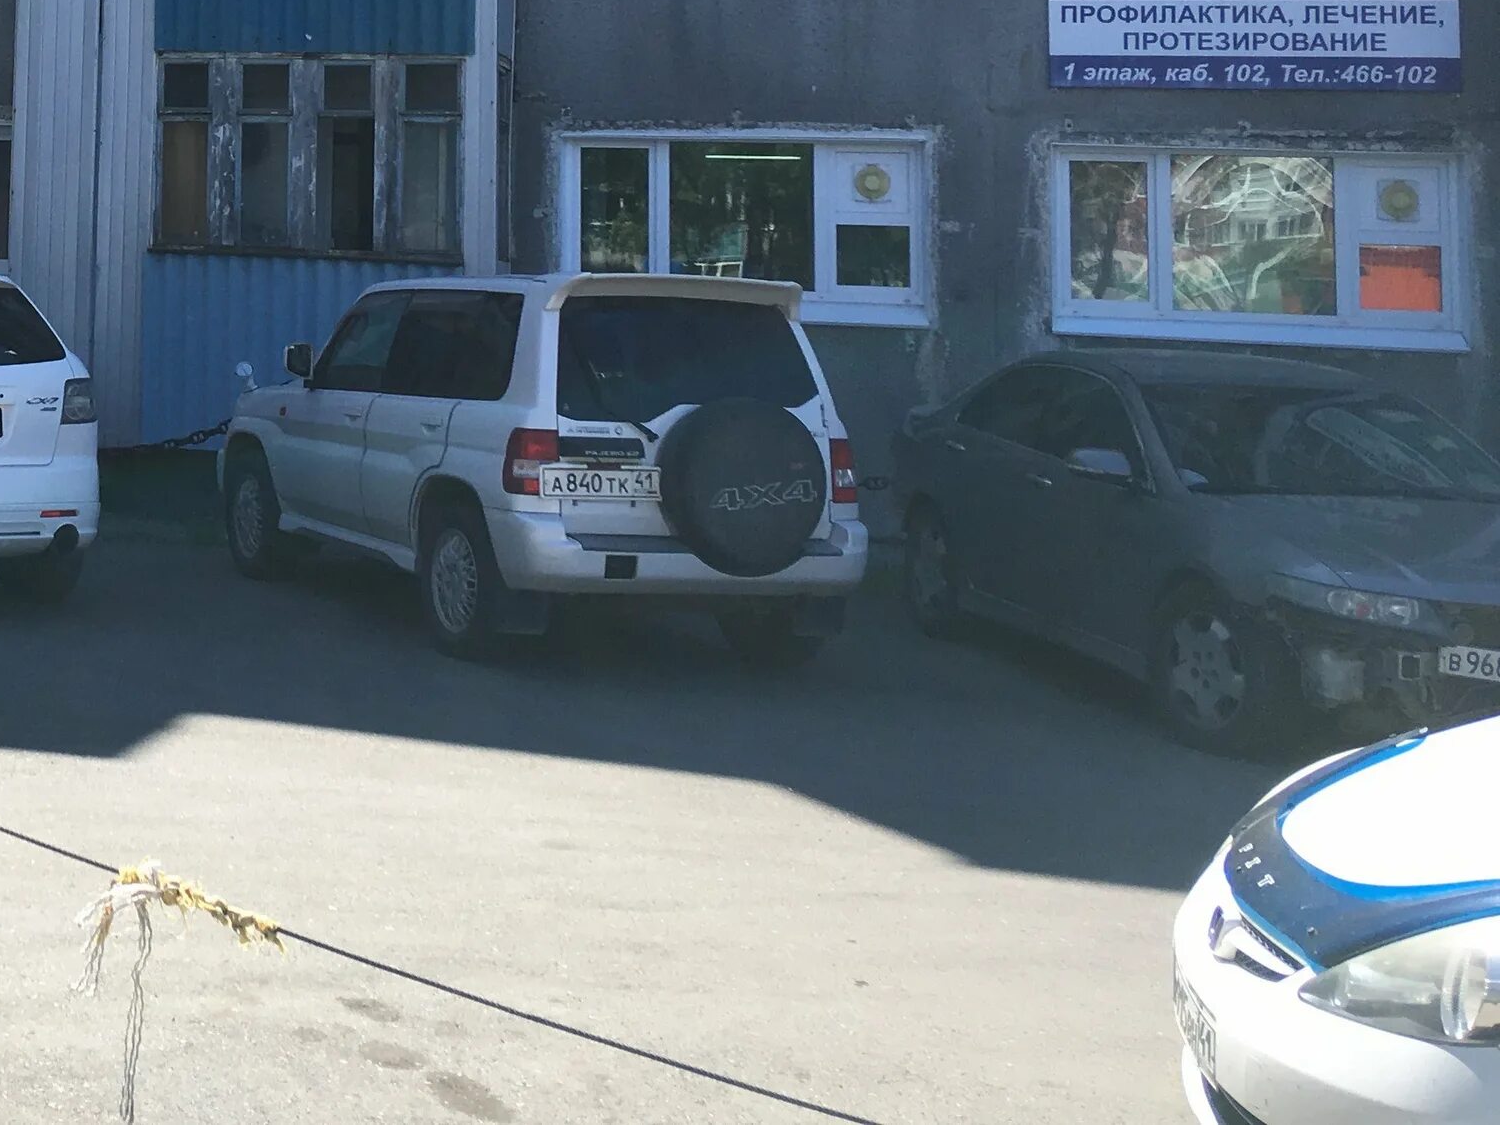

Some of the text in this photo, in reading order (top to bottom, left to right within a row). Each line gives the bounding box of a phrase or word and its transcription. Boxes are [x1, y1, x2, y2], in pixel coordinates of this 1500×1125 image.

[1060, 4, 1445, 28] ПРОФИЛАКТИКА, ЛЕЧЕНИЕ,
[1122, 32, 1388, 52] ПРОТЕЗИРОВАНИЕ
[1063, 64, 1074, 80] 1
[1083, 65, 1157, 84] этаж,
[1165, 64, 1214, 82] каб.
[1224, 65, 1271, 85] 102,
